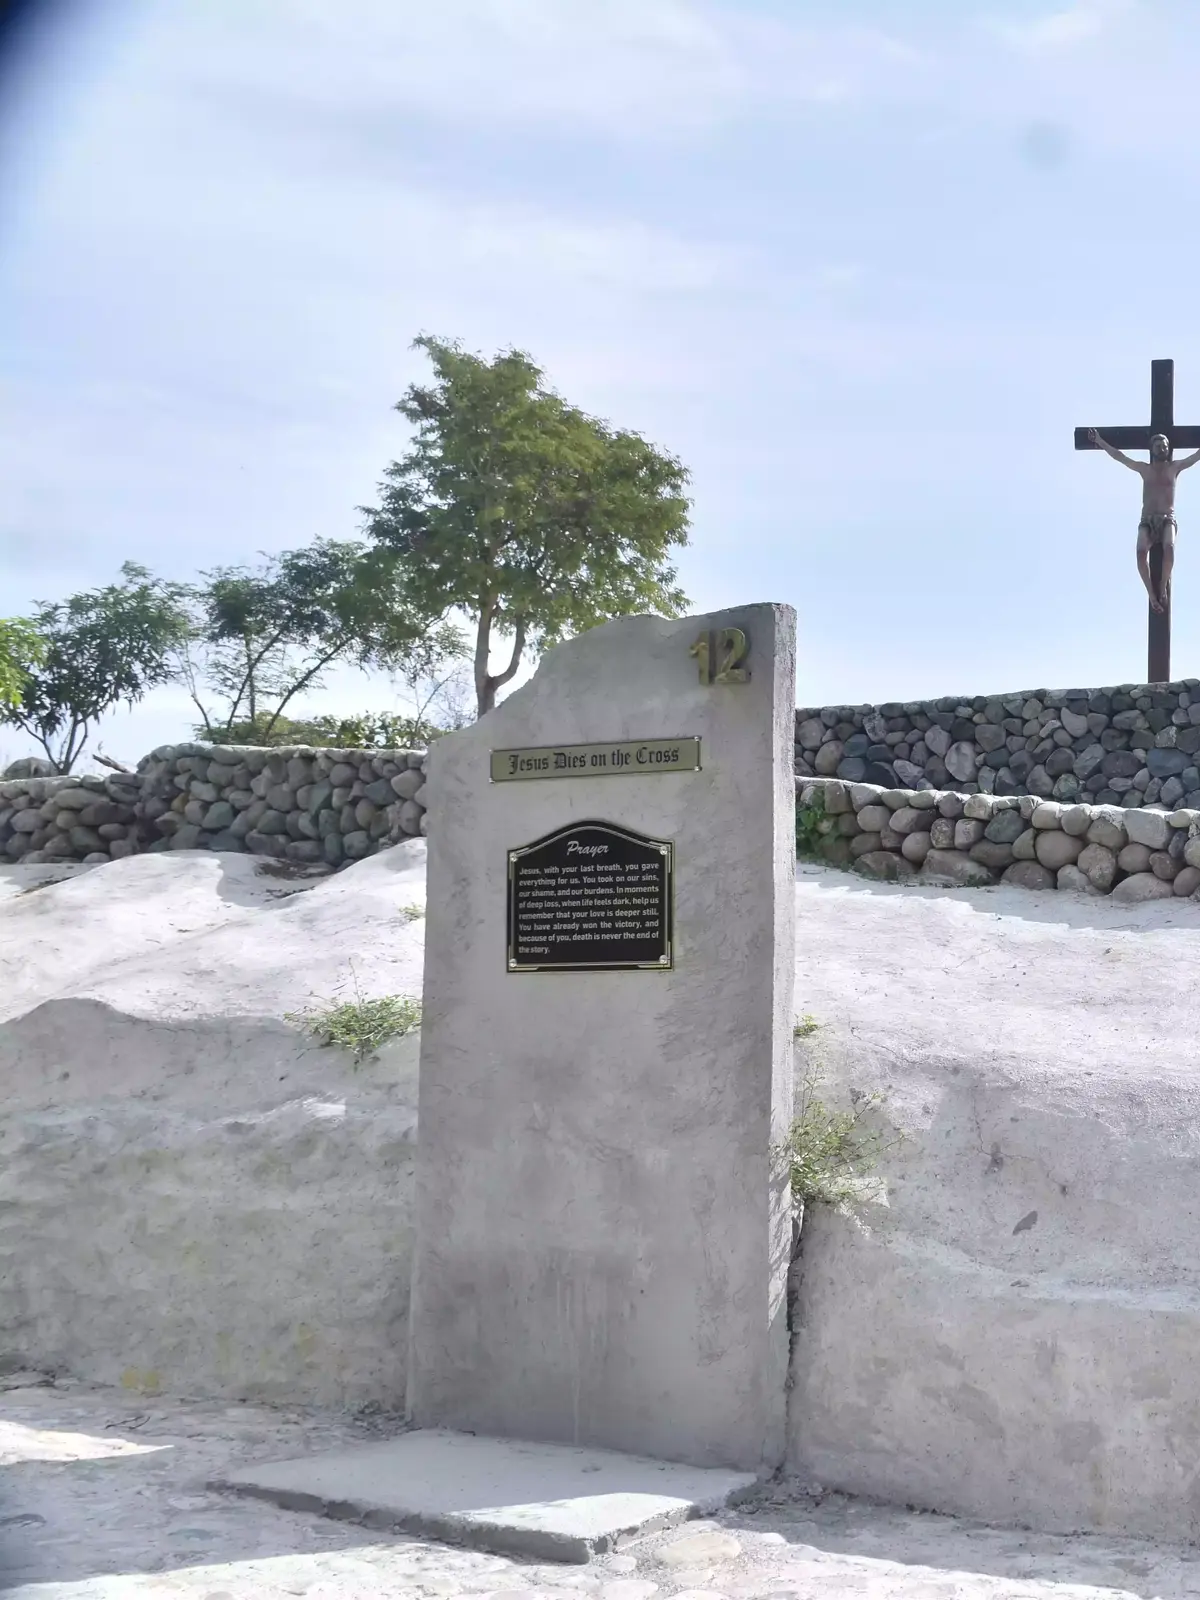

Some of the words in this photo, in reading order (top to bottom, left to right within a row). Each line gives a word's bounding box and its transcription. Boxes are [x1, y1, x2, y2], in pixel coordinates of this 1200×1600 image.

[690, 628, 747, 684] 12
[509, 754, 549, 774] Jesus
[554, 752, 586, 769] Dies
[591, 755, 606, 766] on
[612, 750, 631, 768] the
[636, 747, 679, 764] Cross
[567, 841, 609, 857] Prayer
[625, 864, 638, 872] you
[642, 863, 659, 871] gave
[519, 878, 556, 886] everything
[625, 885, 659, 893] moments
[527, 901, 543, 909] deep
[633, 897, 649, 905] help
[615, 909, 640, 917] deeper
